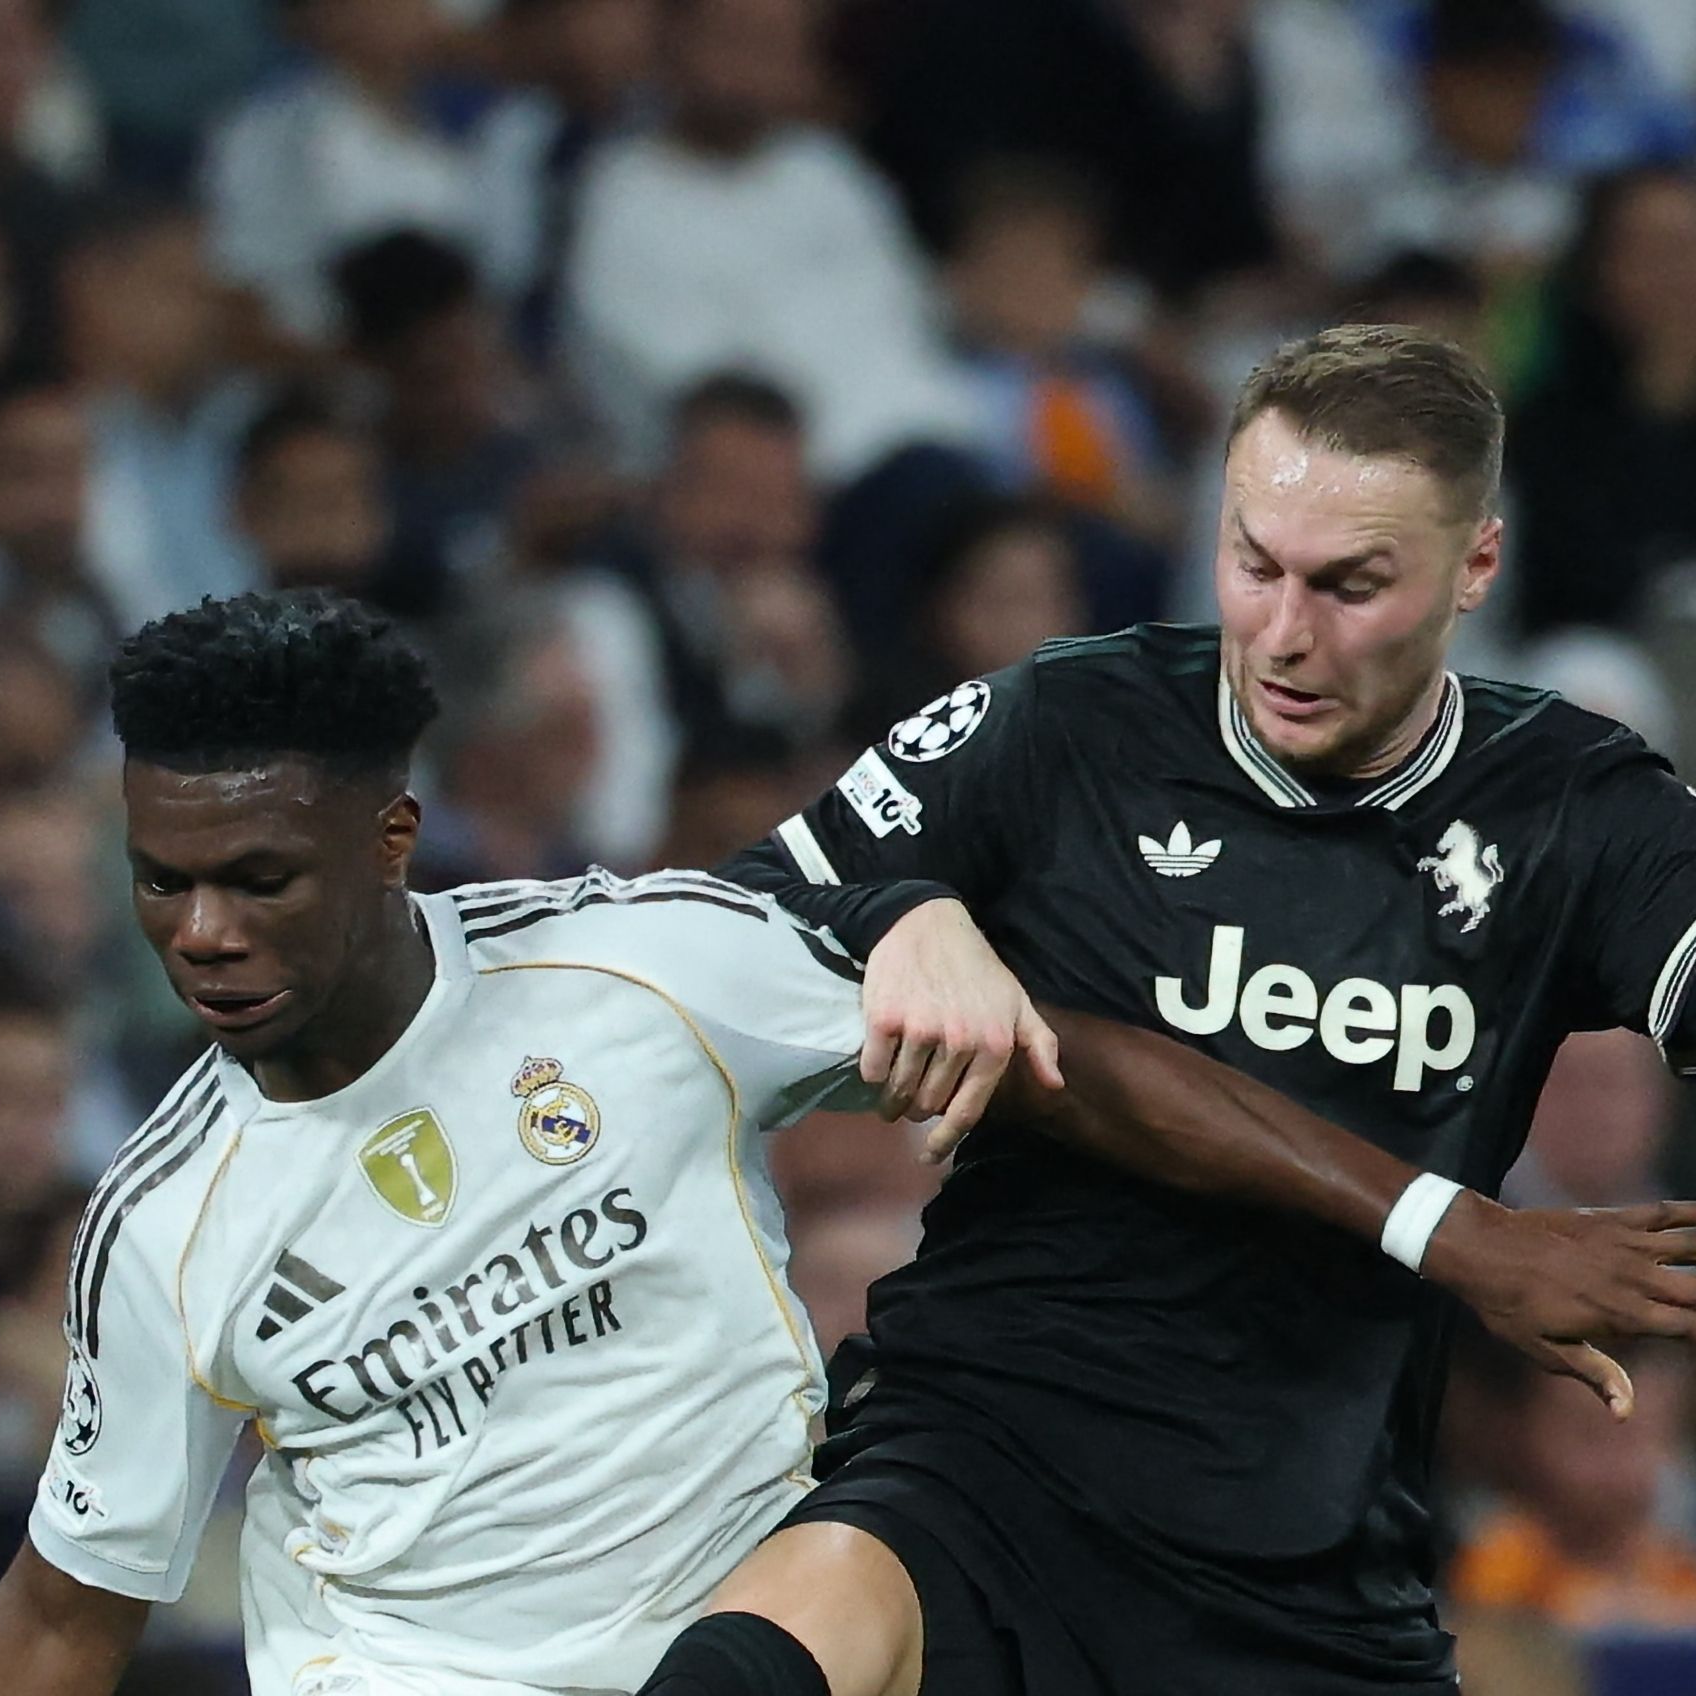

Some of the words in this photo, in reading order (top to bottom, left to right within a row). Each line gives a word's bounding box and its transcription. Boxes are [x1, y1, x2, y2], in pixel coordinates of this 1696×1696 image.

[1154, 925, 1477, 1092] Jeep
[289, 1186, 648, 1424] Emirates
[396, 1375, 468, 1460] FLY
